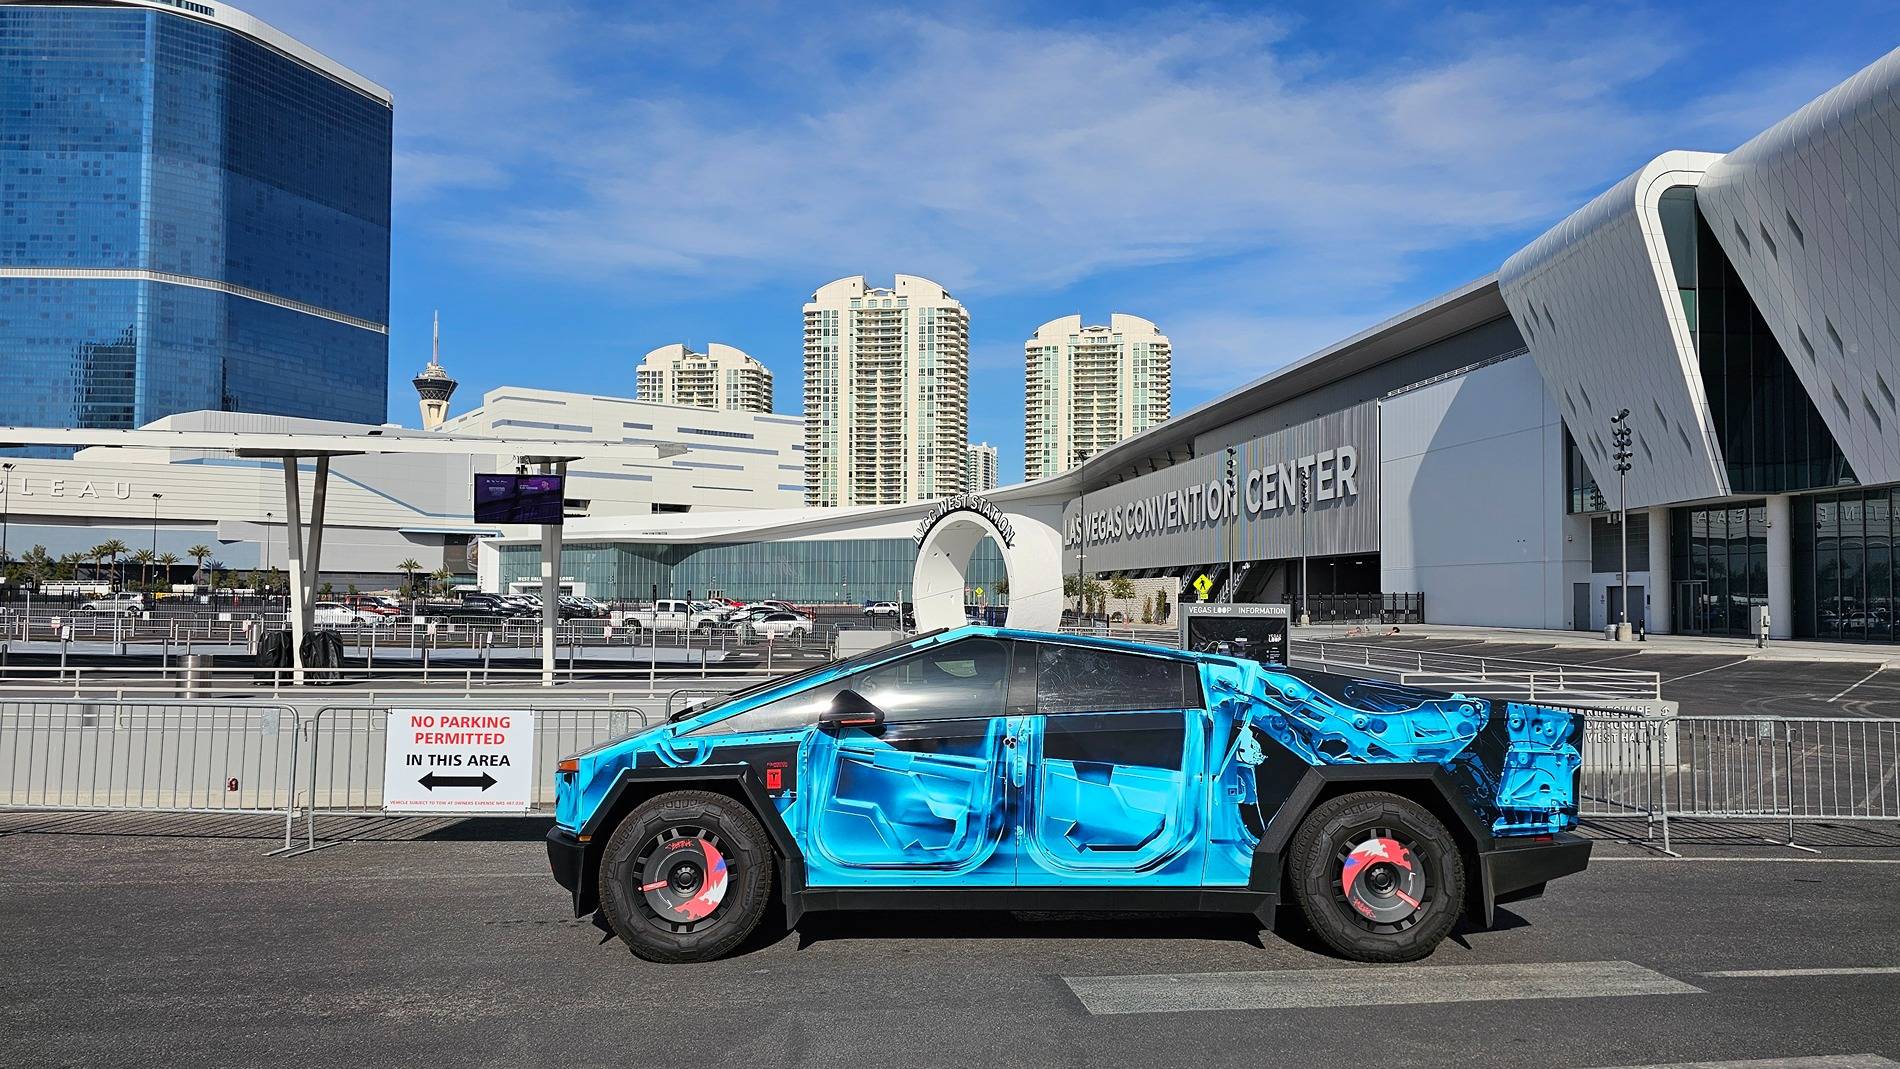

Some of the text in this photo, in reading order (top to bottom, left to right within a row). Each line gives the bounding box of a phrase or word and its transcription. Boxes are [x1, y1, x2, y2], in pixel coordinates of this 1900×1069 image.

[1065, 445, 1357, 546] LAS VEGAS CONVENTION CENTER
[912, 494, 1015, 545] LVCC WEST STATION
[1188, 606, 1286, 615] VEGAS LOOP INFORMATION
[411, 715, 511, 729] NO PARKING
[415, 732, 505, 745] PERMITTED
[406, 754, 511, 767] IN THIS AREA
